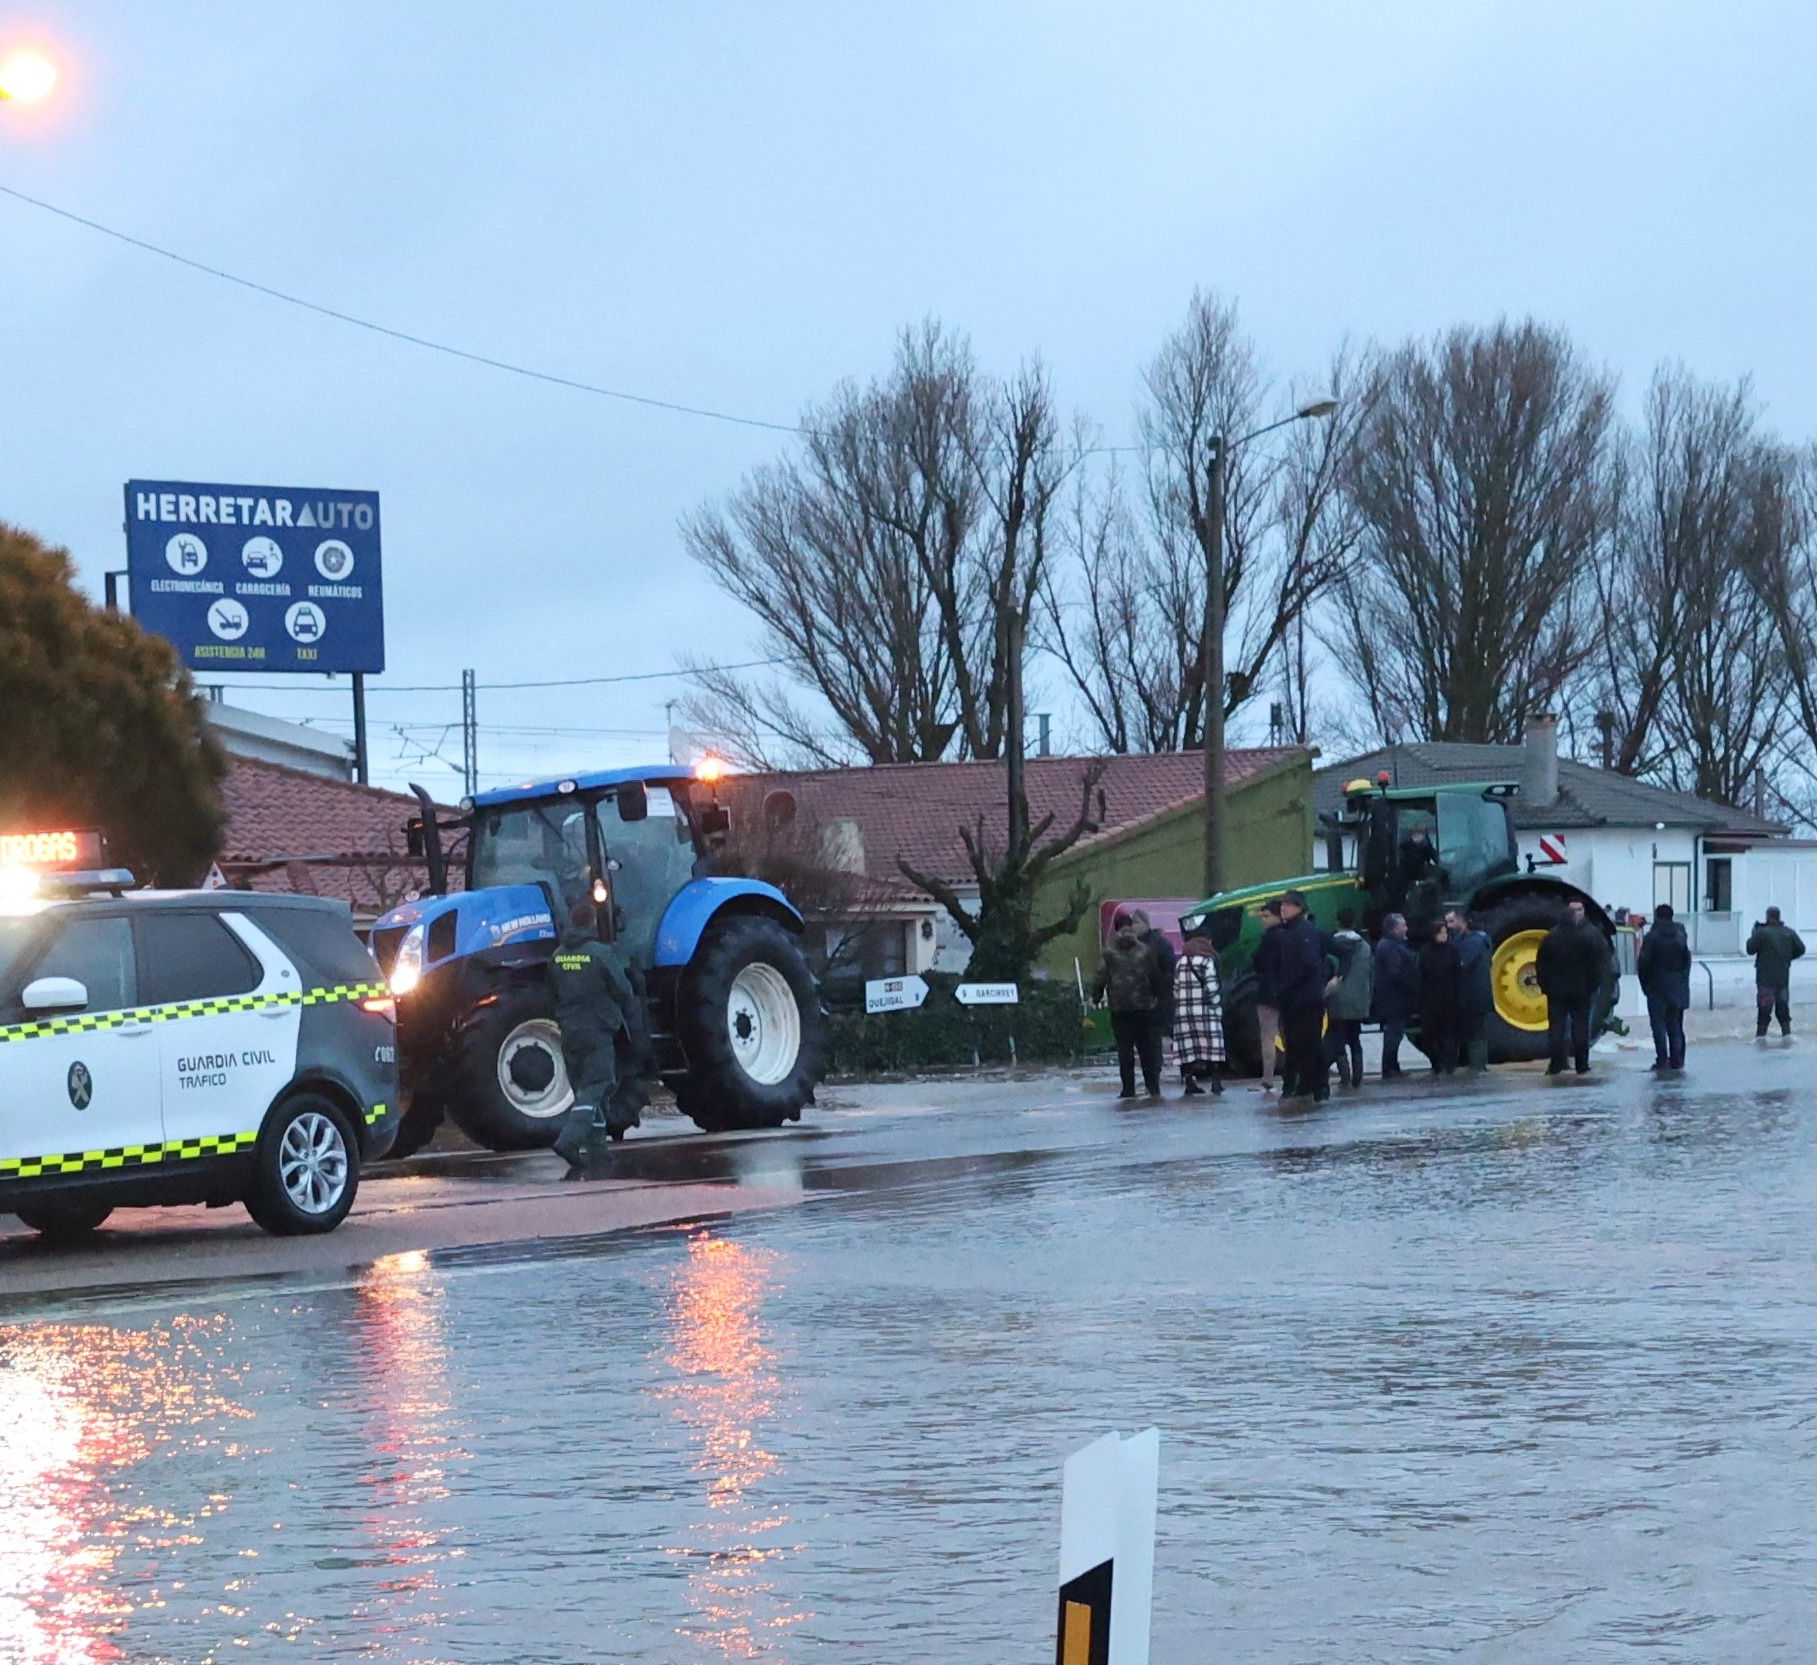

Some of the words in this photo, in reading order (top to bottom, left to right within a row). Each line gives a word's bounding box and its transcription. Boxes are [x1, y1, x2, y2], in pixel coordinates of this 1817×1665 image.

[236, 582, 291, 597] CARROCERÍA
[194, 645, 246, 659] ASISTENCIA
[297, 647, 318, 661] TAXI
[0, 831, 77, 863] DROGAS
[501, 919, 519, 934] NEW
[518, 913, 551, 927] HOLLAND
[554, 954, 591, 963] GUARDIA
[177, 1053, 237, 1072] GUARDIA
[242, 1049, 276, 1066] CIVIL
